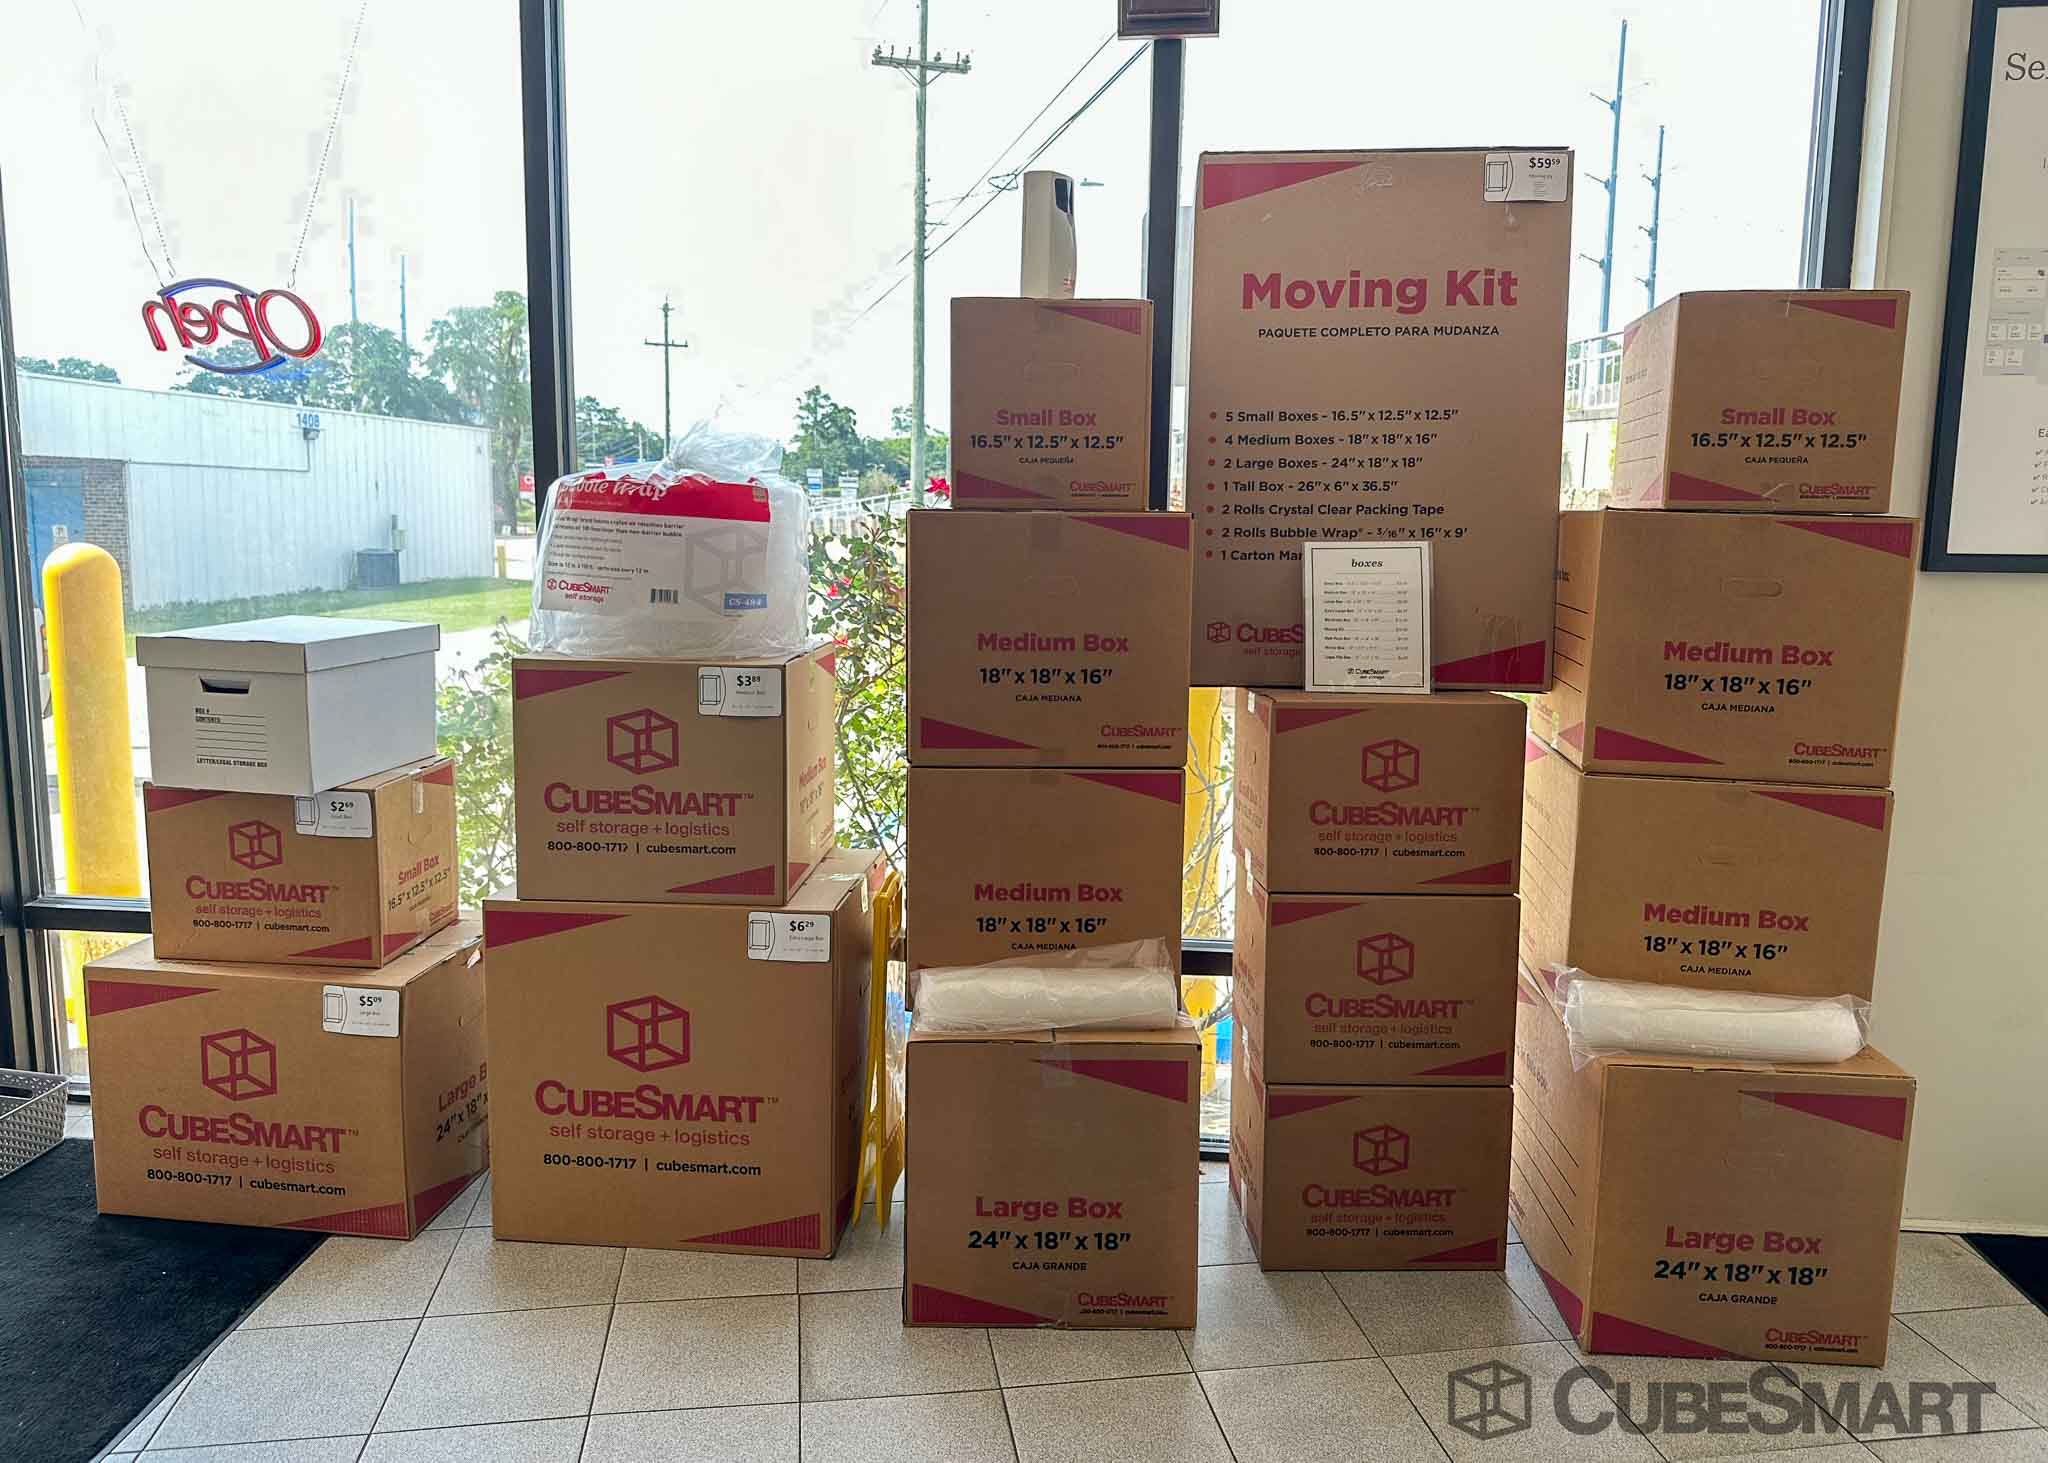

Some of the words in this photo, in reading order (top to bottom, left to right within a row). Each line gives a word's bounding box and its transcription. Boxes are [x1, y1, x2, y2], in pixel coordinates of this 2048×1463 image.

[2006, 52, 2048, 80] Se
[1242, 270, 1428, 315] Moving
[1445, 268, 1519, 307] Kit
[1258, 327, 1317, 339] PAQUETE
[1320, 326, 1391, 338] COMPLETO
[1395, 326, 1430, 337] PARA
[1433, 325, 1499, 337] MUDANZA
[297, 412, 320, 428] 1408
[997, 409, 1053, 426] Small
[1058, 410, 1097, 426] Box
[1226, 411, 1234, 422] 5
[1238, 410, 1274, 422] Small
[1278, 410, 1318, 422] Boxes
[1721, 407, 1784, 426] Small
[1790, 408, 1837, 426] Box
[1224, 434, 1233, 446] 4
[1238, 434, 1290, 446] Medium
[1295, 434, 1335, 446] Boxes
[1224, 458, 1232, 468] 2
[1236, 458, 1274, 471] Large
[1278, 458, 1318, 468] Boxes
[1744, 456, 1768, 465] CAJA
[1232, 480, 1254, 492] Tall
[1258, 480, 1284, 492] Box
[1222, 504, 1230, 515] 2
[1234, 504, 1266, 515] Rolls
[1268, 504, 1314, 518] Crystal
[1318, 504, 1352, 515] Clear
[1356, 504, 1408, 518] Packing
[1412, 504, 1444, 517] Tape
[1222, 528, 1230, 538] 2
[1234, 527, 1266, 538] Rolls
[1270, 527, 1318, 538] Bubble
[1230, 550, 1282, 562] Carton
[1352, 558, 1384, 568] boxes
[977, 632, 1076, 652] Medium
[1084, 634, 1129, 653] Box
[1663, 640, 1773, 666] Medium
[1782, 644, 1834, 667] Box
[1016, 694, 1038, 702] CAJA
[1041, 694, 1082, 702] MEDIANA
[1701, 702, 1727, 712] CAJA
[1730, 704, 1775, 713] MEDIANA
[557, 820, 585, 834] self
[590, 822, 648, 838] storage
[666, 822, 730, 838] logistics
[646, 843, 736, 856] cubesmart.com
[1392, 848, 1465, 858] cubesmart.com
[974, 883, 1071, 902] Medium
[1078, 884, 1123, 902] Box
[1644, 903, 1750, 928] Medium
[1758, 910, 1810, 932] Box
[264, 922, 330, 933] cubesmart.com
[1680, 964, 1706, 974] CAJA
[1708, 966, 1752, 977] MEDIANA
[549, 1122, 583, 1138] self
[587, 1125, 656, 1144] storage
[674, 1128, 750, 1147] logistics
[152, 1144, 182, 1160] self
[186, 1150, 248, 1169] storage
[266, 1153, 335, 1174] logistics
[543, 1154, 636, 1170] 800-800-1717
[656, 1159, 761, 1176] cubesmart.com
[147, 1169, 232, 1187] 800-800-1717
[250, 1177, 346, 1196] cubesmart.com
[976, 1196, 1058, 1222] Large
[1068, 1197, 1123, 1220] Box
[1665, 1226, 1756, 1255] Large
[1762, 1230, 1823, 1256] Box
[1012, 1262, 1040, 1270] CAJA
[1042, 1262, 1088, 1272] GRANDE
[1698, 1292, 1728, 1304] CAJA
[1730, 1294, 1778, 1305] GRANDE
